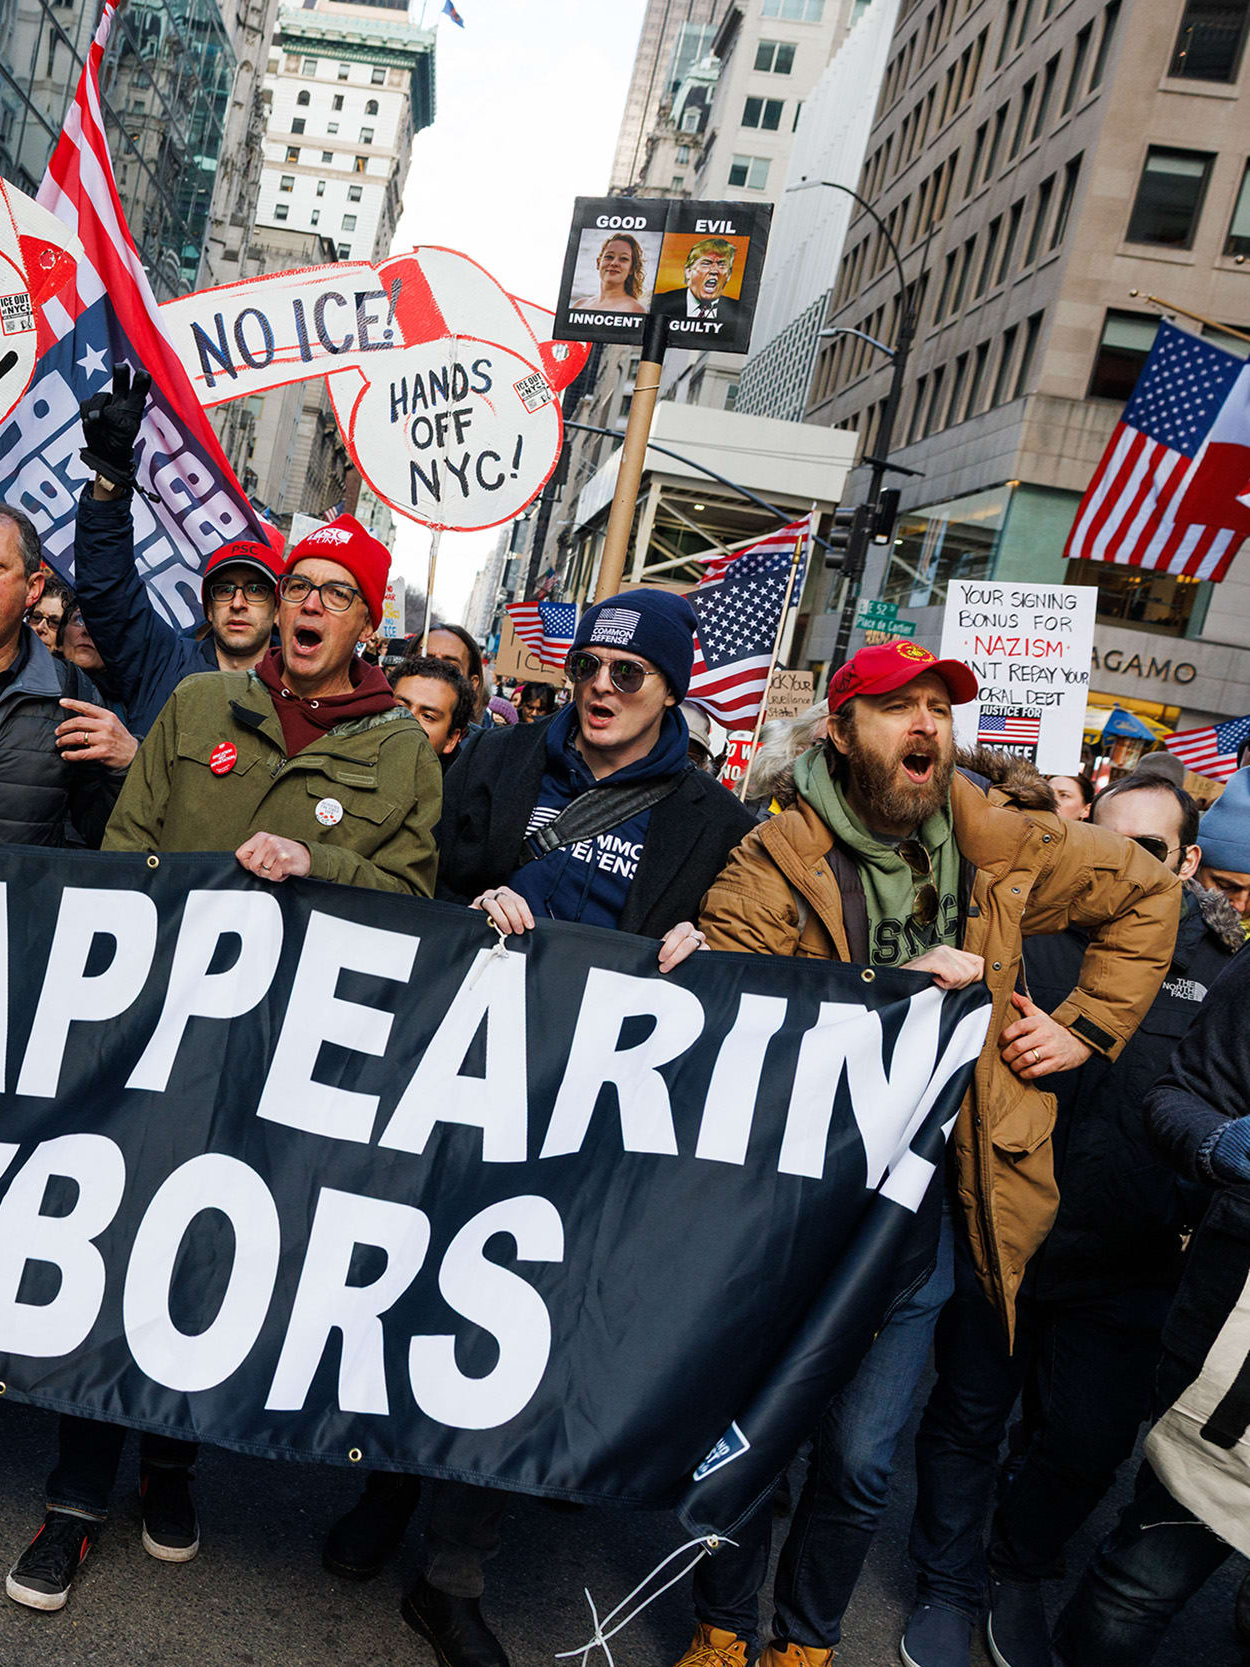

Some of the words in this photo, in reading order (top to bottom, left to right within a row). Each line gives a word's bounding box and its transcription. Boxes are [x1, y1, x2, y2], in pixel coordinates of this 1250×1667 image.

[596, 215, 647, 230] GOOD
[695, 219, 736, 234] EVIL
[0, 297, 12, 307] ICE
[14, 294, 29, 304] OUT
[568, 312, 643, 329] INNOCENT
[669, 320, 724, 334] GUILTY
[190, 308, 275, 388] NO
[292, 277, 404, 362] ICE!
[389, 358, 494, 423] HANDS
[516, 381, 528, 391] ICE
[528, 373, 541, 384] OUT
[410, 407, 474, 450] OFF
[409, 433, 525, 506] NYC!
[231, 544, 258, 556] PSC
[960, 585, 1004, 607] YOUR
[1010, 591, 1078, 610] SIGNING
[876, 603, 888, 615] 52
[858, 616, 875, 629] Place
[877, 620, 887, 630] de
[888, 621, 912, 635] Cartier
[959, 610, 1019, 628] BONUS
[1033, 615, 1073, 633] FOR
[589, 634, 630, 646] DEFENSE
[592, 627, 635, 640] COMMON
[974, 635, 1064, 658] NAZISM
[1092, 646, 1198, 685] AGAMO
[1008, 663, 1058, 684] REPAY
[1060, 667, 1089, 686] YOUR
[973, 687, 1023, 706] ORAL
[1026, 692, 1066, 706] DEBT
[979, 705, 1019, 717] JUSTICE
[1022, 707, 1042, 718] FOR
[1162, 981, 1196, 994] NORTH
[1177, 977, 1196, 988] THE
[1170, 989, 1195, 1000] FACE
